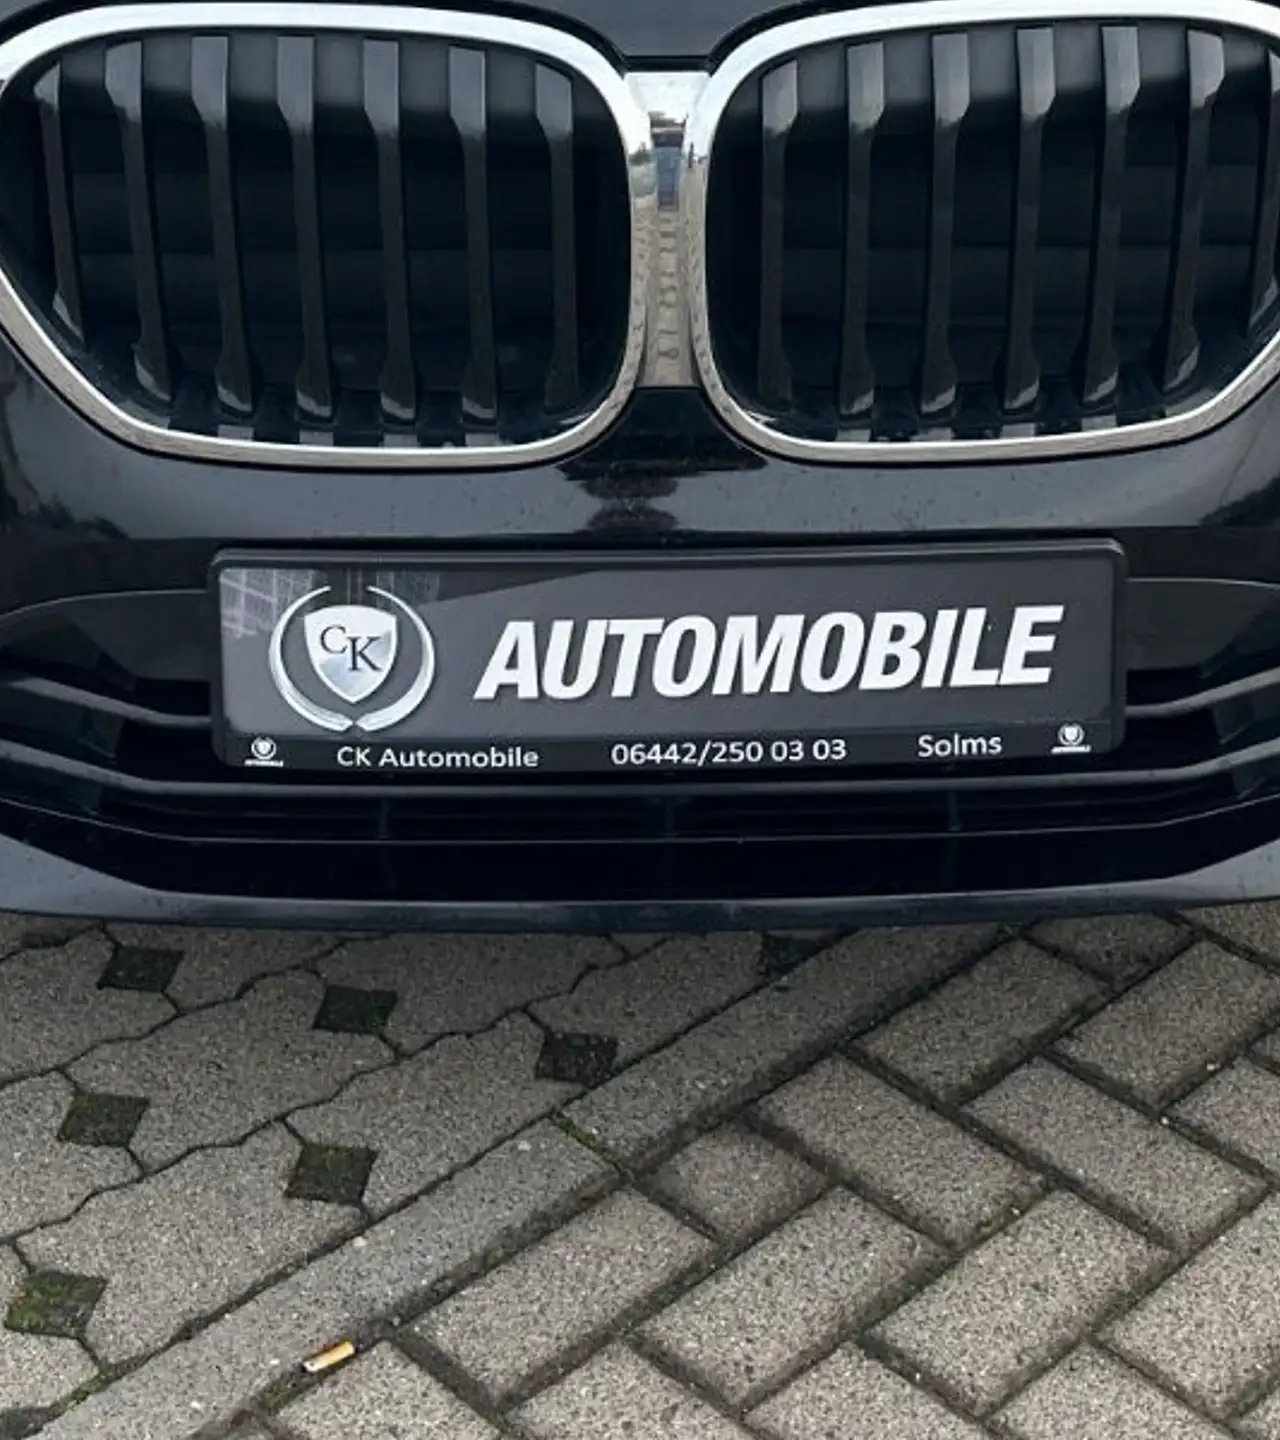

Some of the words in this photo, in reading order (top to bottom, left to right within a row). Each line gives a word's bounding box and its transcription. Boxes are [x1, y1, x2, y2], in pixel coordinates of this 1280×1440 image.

[320, 625, 382, 672] CK
[473, 604, 1064, 701] AUTOMOBILE
[337, 746, 372, 768] CK
[378, 746, 540, 769] Automobile
[611, 738, 764, 768] 06442/250
[770, 739, 805, 761] 03
[812, 738, 848, 761] 03
[918, 733, 1003, 758] Solms
